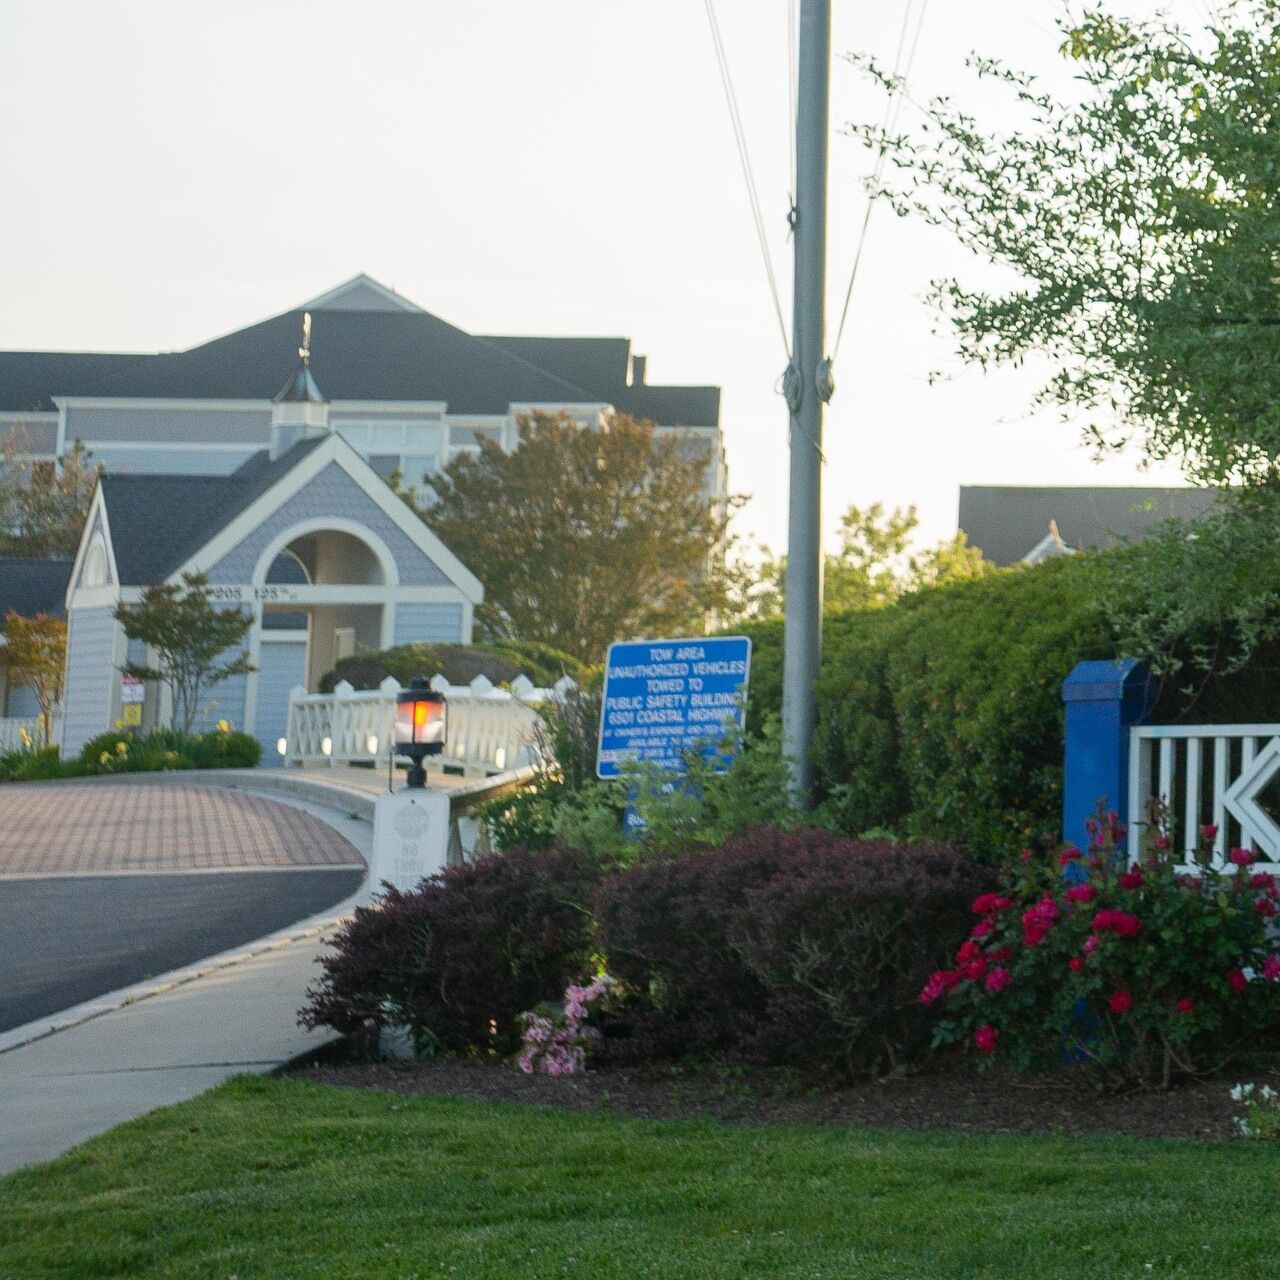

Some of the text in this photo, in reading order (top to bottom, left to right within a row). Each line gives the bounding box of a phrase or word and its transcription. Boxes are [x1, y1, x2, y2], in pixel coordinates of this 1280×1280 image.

[650, 647, 706, 661] TOW AREA
[608, 660, 746, 679] UNAUTHORIZED VEHICLES
[646, 677, 704, 693] TOWED TO
[606, 691, 743, 711] PUBLIC SAFETY BUILDING
[636, 709, 685, 724] COASTAL
[687, 707, 738, 721] HIGHWAY
